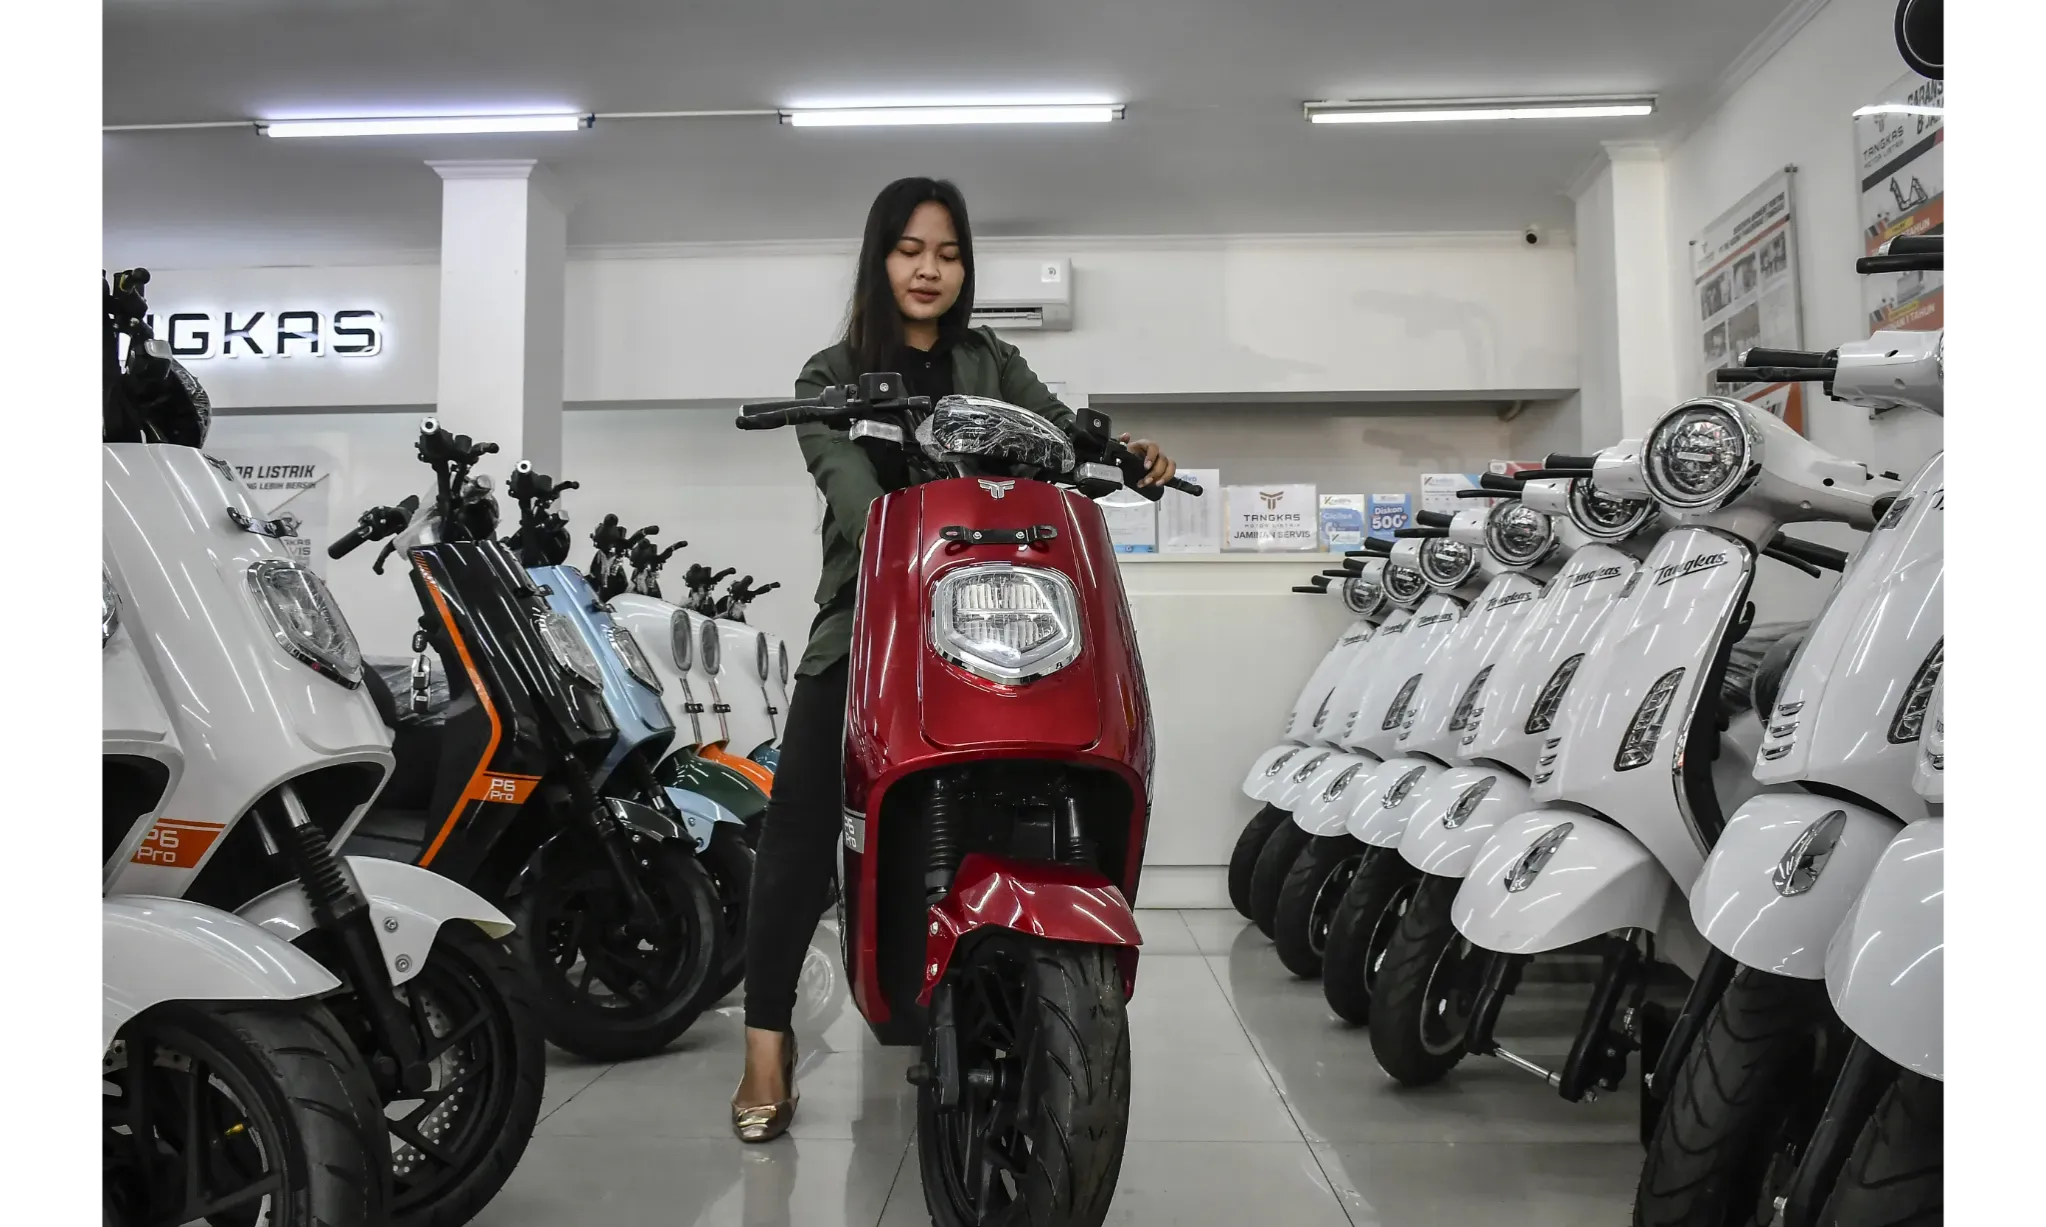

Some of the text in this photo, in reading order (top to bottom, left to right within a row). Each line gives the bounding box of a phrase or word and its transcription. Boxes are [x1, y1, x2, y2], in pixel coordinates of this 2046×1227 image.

[257, 465, 316, 479] LISTRIK
[490, 777, 516, 792] P6
[489, 790, 514, 801] Pro
[136, 846, 177, 863] Pro
